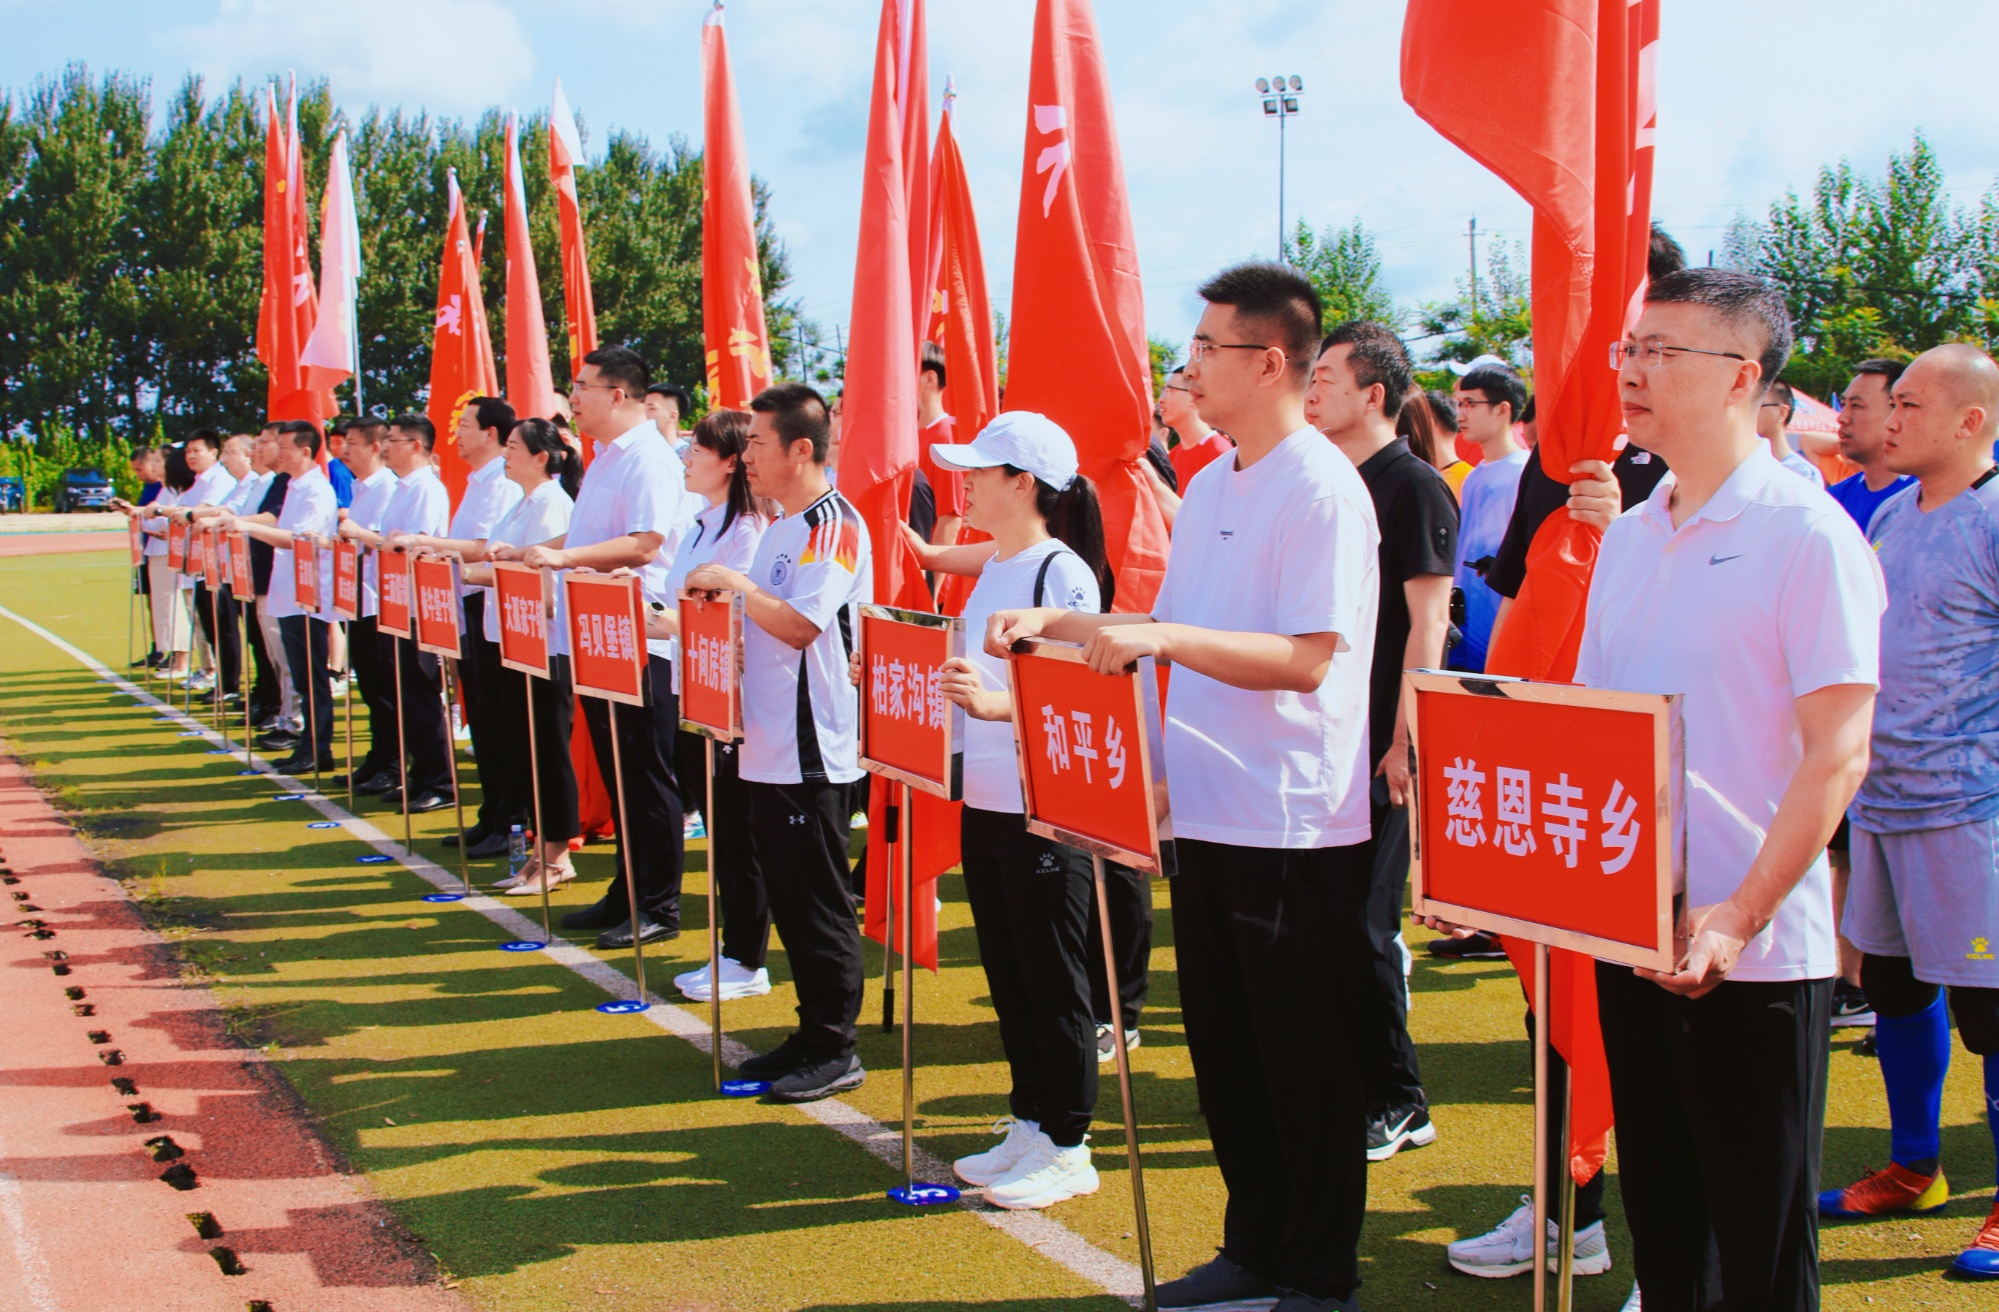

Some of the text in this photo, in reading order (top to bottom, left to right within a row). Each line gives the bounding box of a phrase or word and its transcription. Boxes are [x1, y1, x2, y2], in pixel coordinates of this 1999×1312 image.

[688, 631, 730, 694] 十间房镇
[872, 653, 946, 733] 柏家沟镇
[1041, 704, 1126, 789] 和平乡
[1443, 756, 1641, 875] 慈恩寺乡
